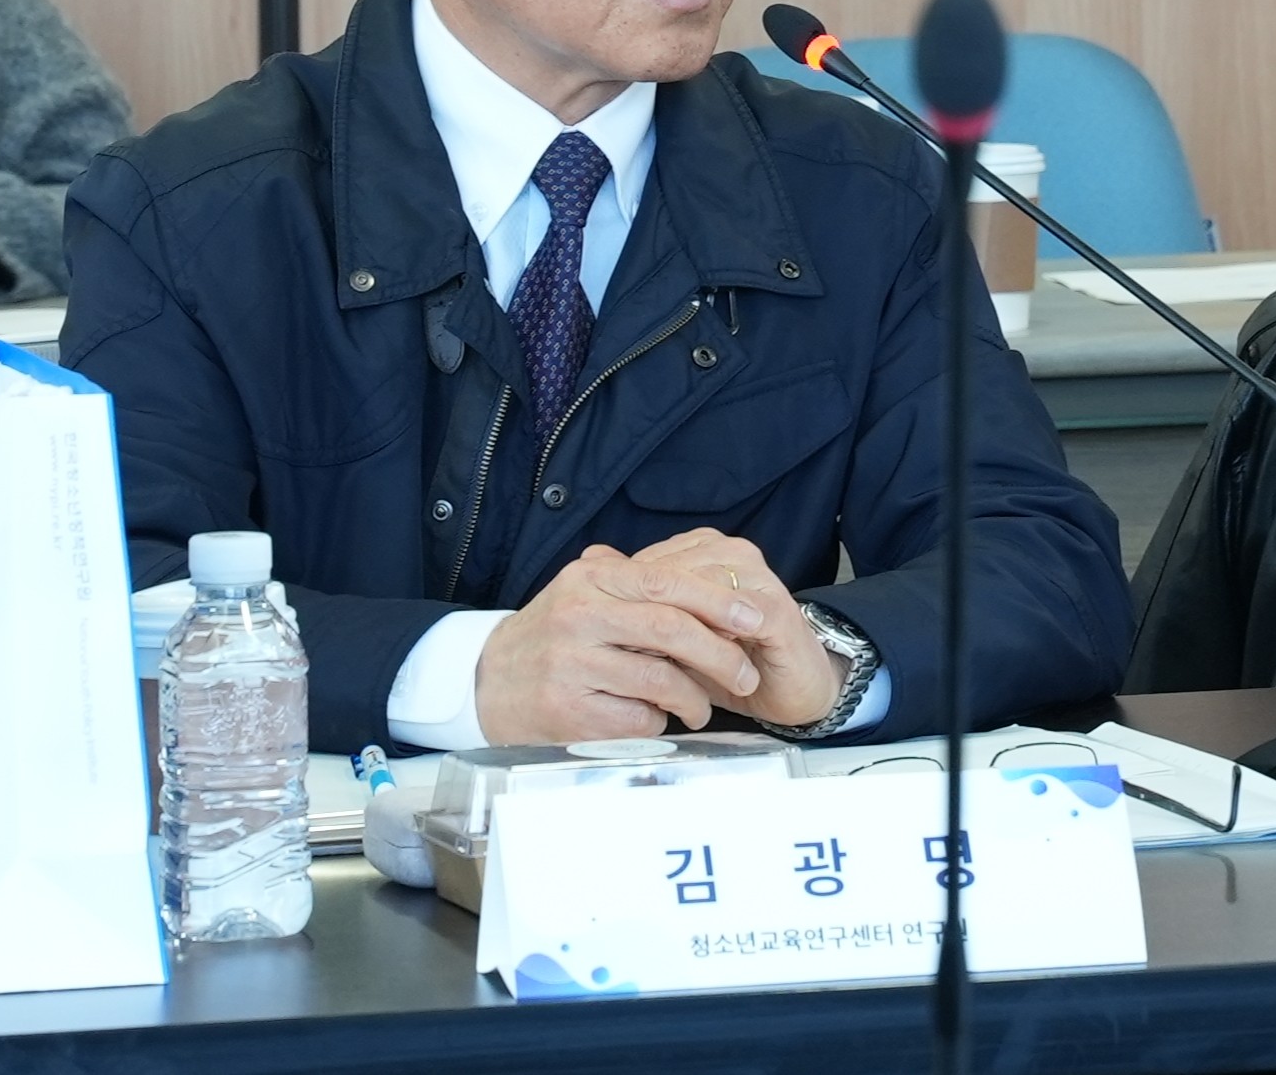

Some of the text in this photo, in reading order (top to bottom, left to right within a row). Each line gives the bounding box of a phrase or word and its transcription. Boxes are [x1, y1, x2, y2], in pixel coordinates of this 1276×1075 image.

[665, 829, 975, 905] 김 광 명
[690, 922, 894, 959] 청소년교육연구센터
